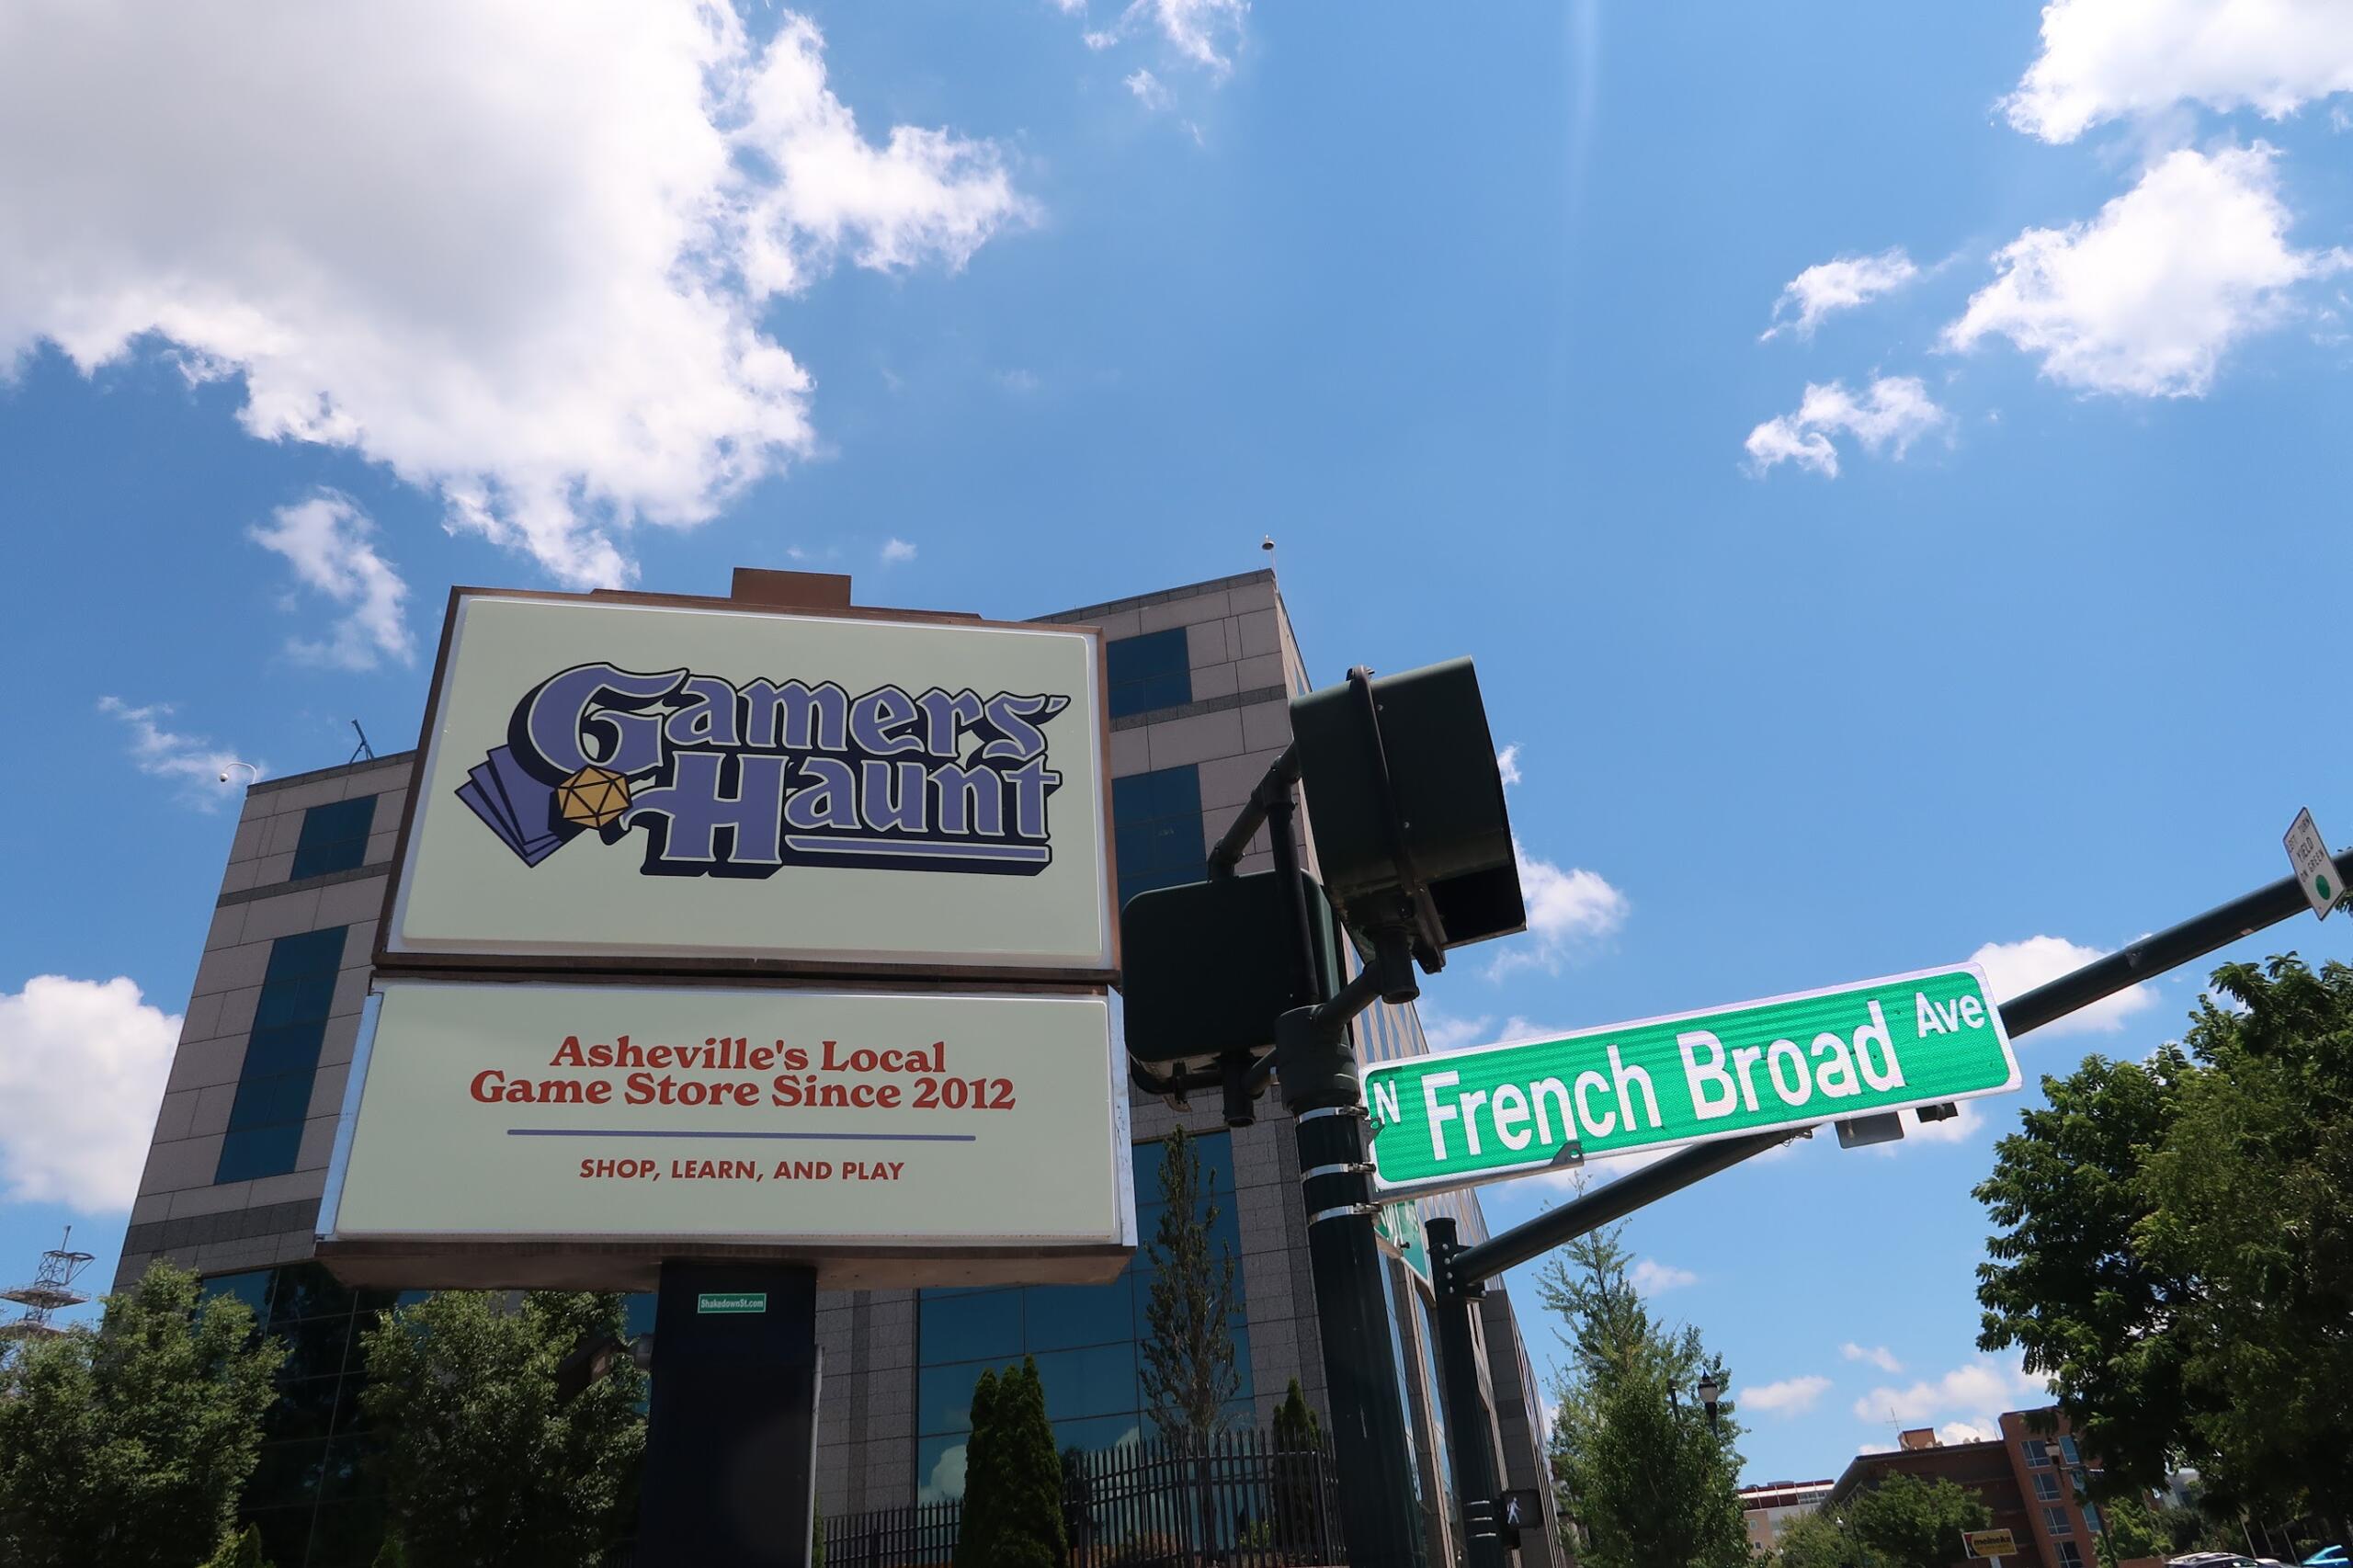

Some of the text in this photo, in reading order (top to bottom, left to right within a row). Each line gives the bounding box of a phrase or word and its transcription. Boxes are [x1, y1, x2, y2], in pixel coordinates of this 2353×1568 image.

[619, 751, 1063, 875] Haunt
[549, 1036, 946, 1074] Asheville's Local
[470, 1070, 1017, 1110] Game Store Since 2012
[1372, 992, 1984, 1161] N French Broad Ave
[579, 1160, 904, 1184] SHOP, LEARN, AND PLAY
[700, 1299, 764, 1309] ShakedownSt.com
